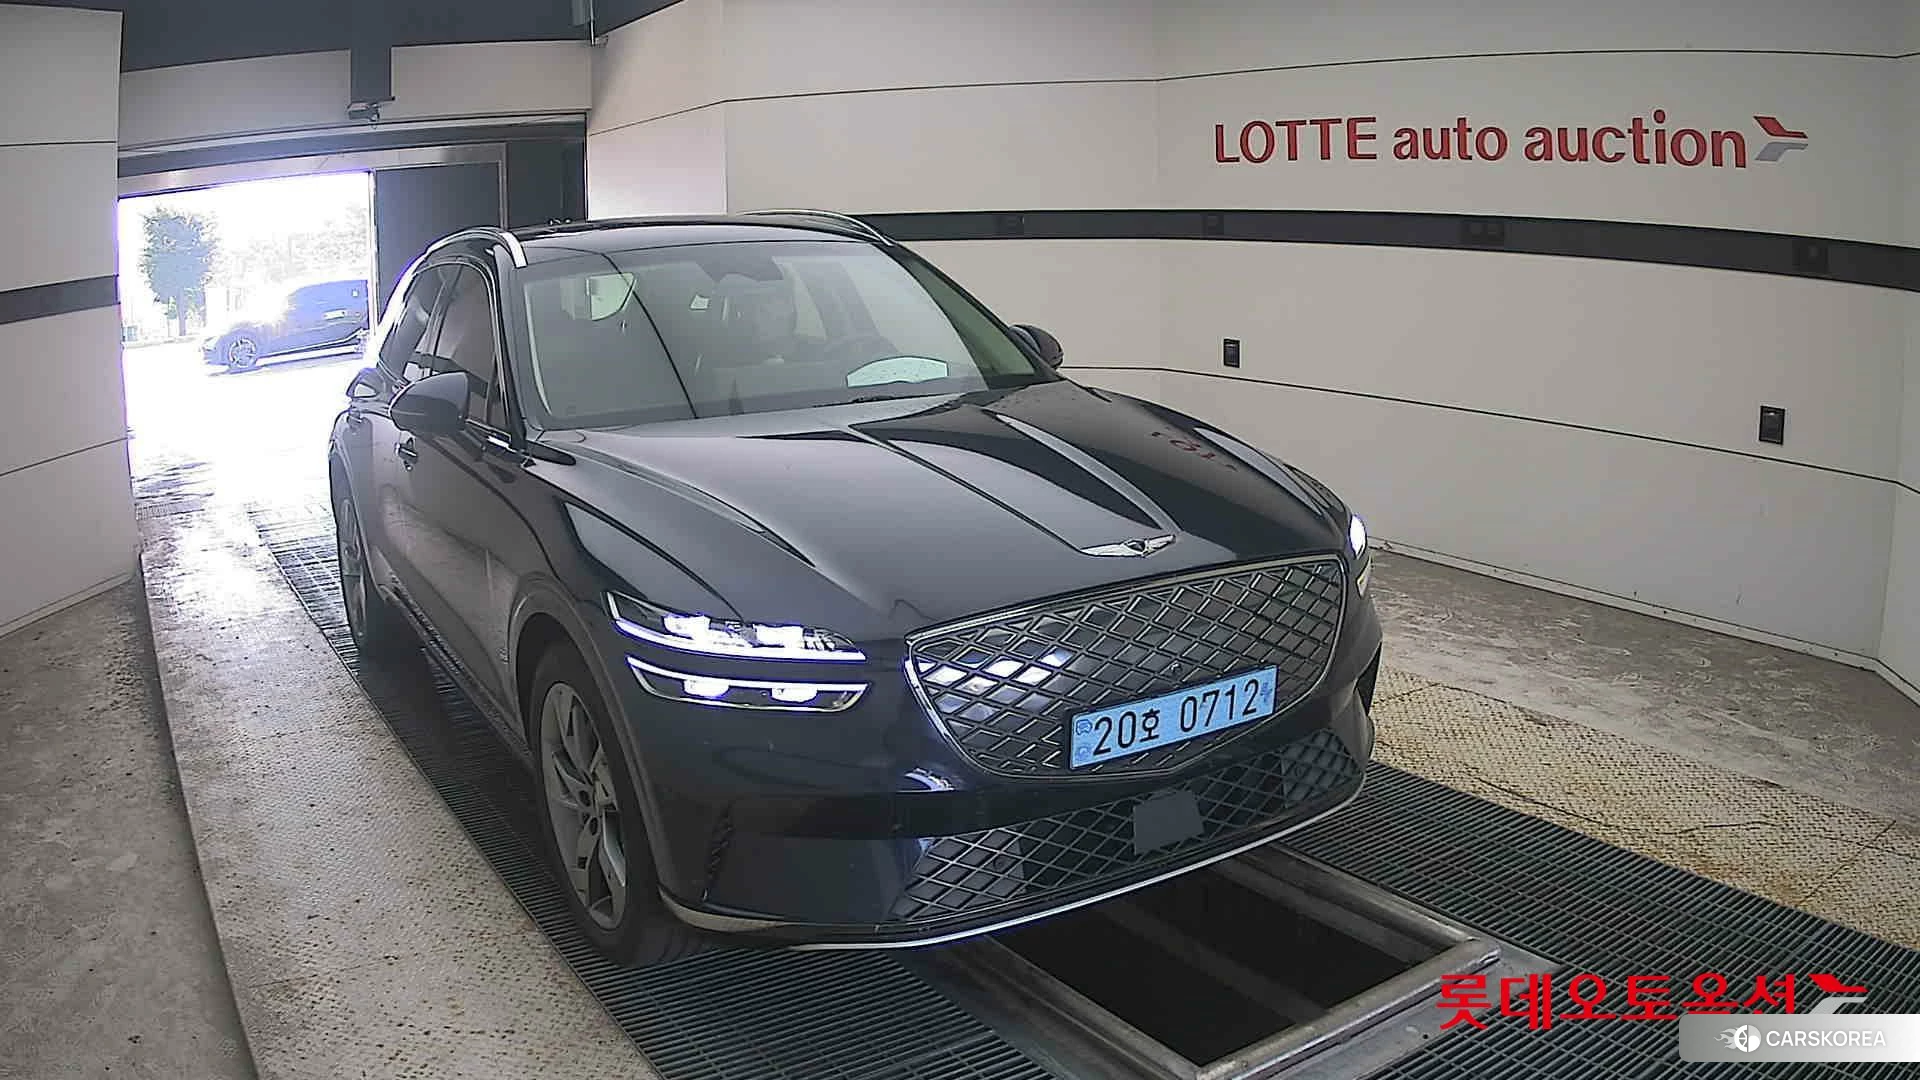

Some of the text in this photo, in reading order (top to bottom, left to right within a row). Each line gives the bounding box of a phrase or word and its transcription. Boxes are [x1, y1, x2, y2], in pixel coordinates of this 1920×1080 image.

[1215, 109, 1747, 169] LOTTE auto auction
[1093, 679, 1260, 756] 20호 0712
